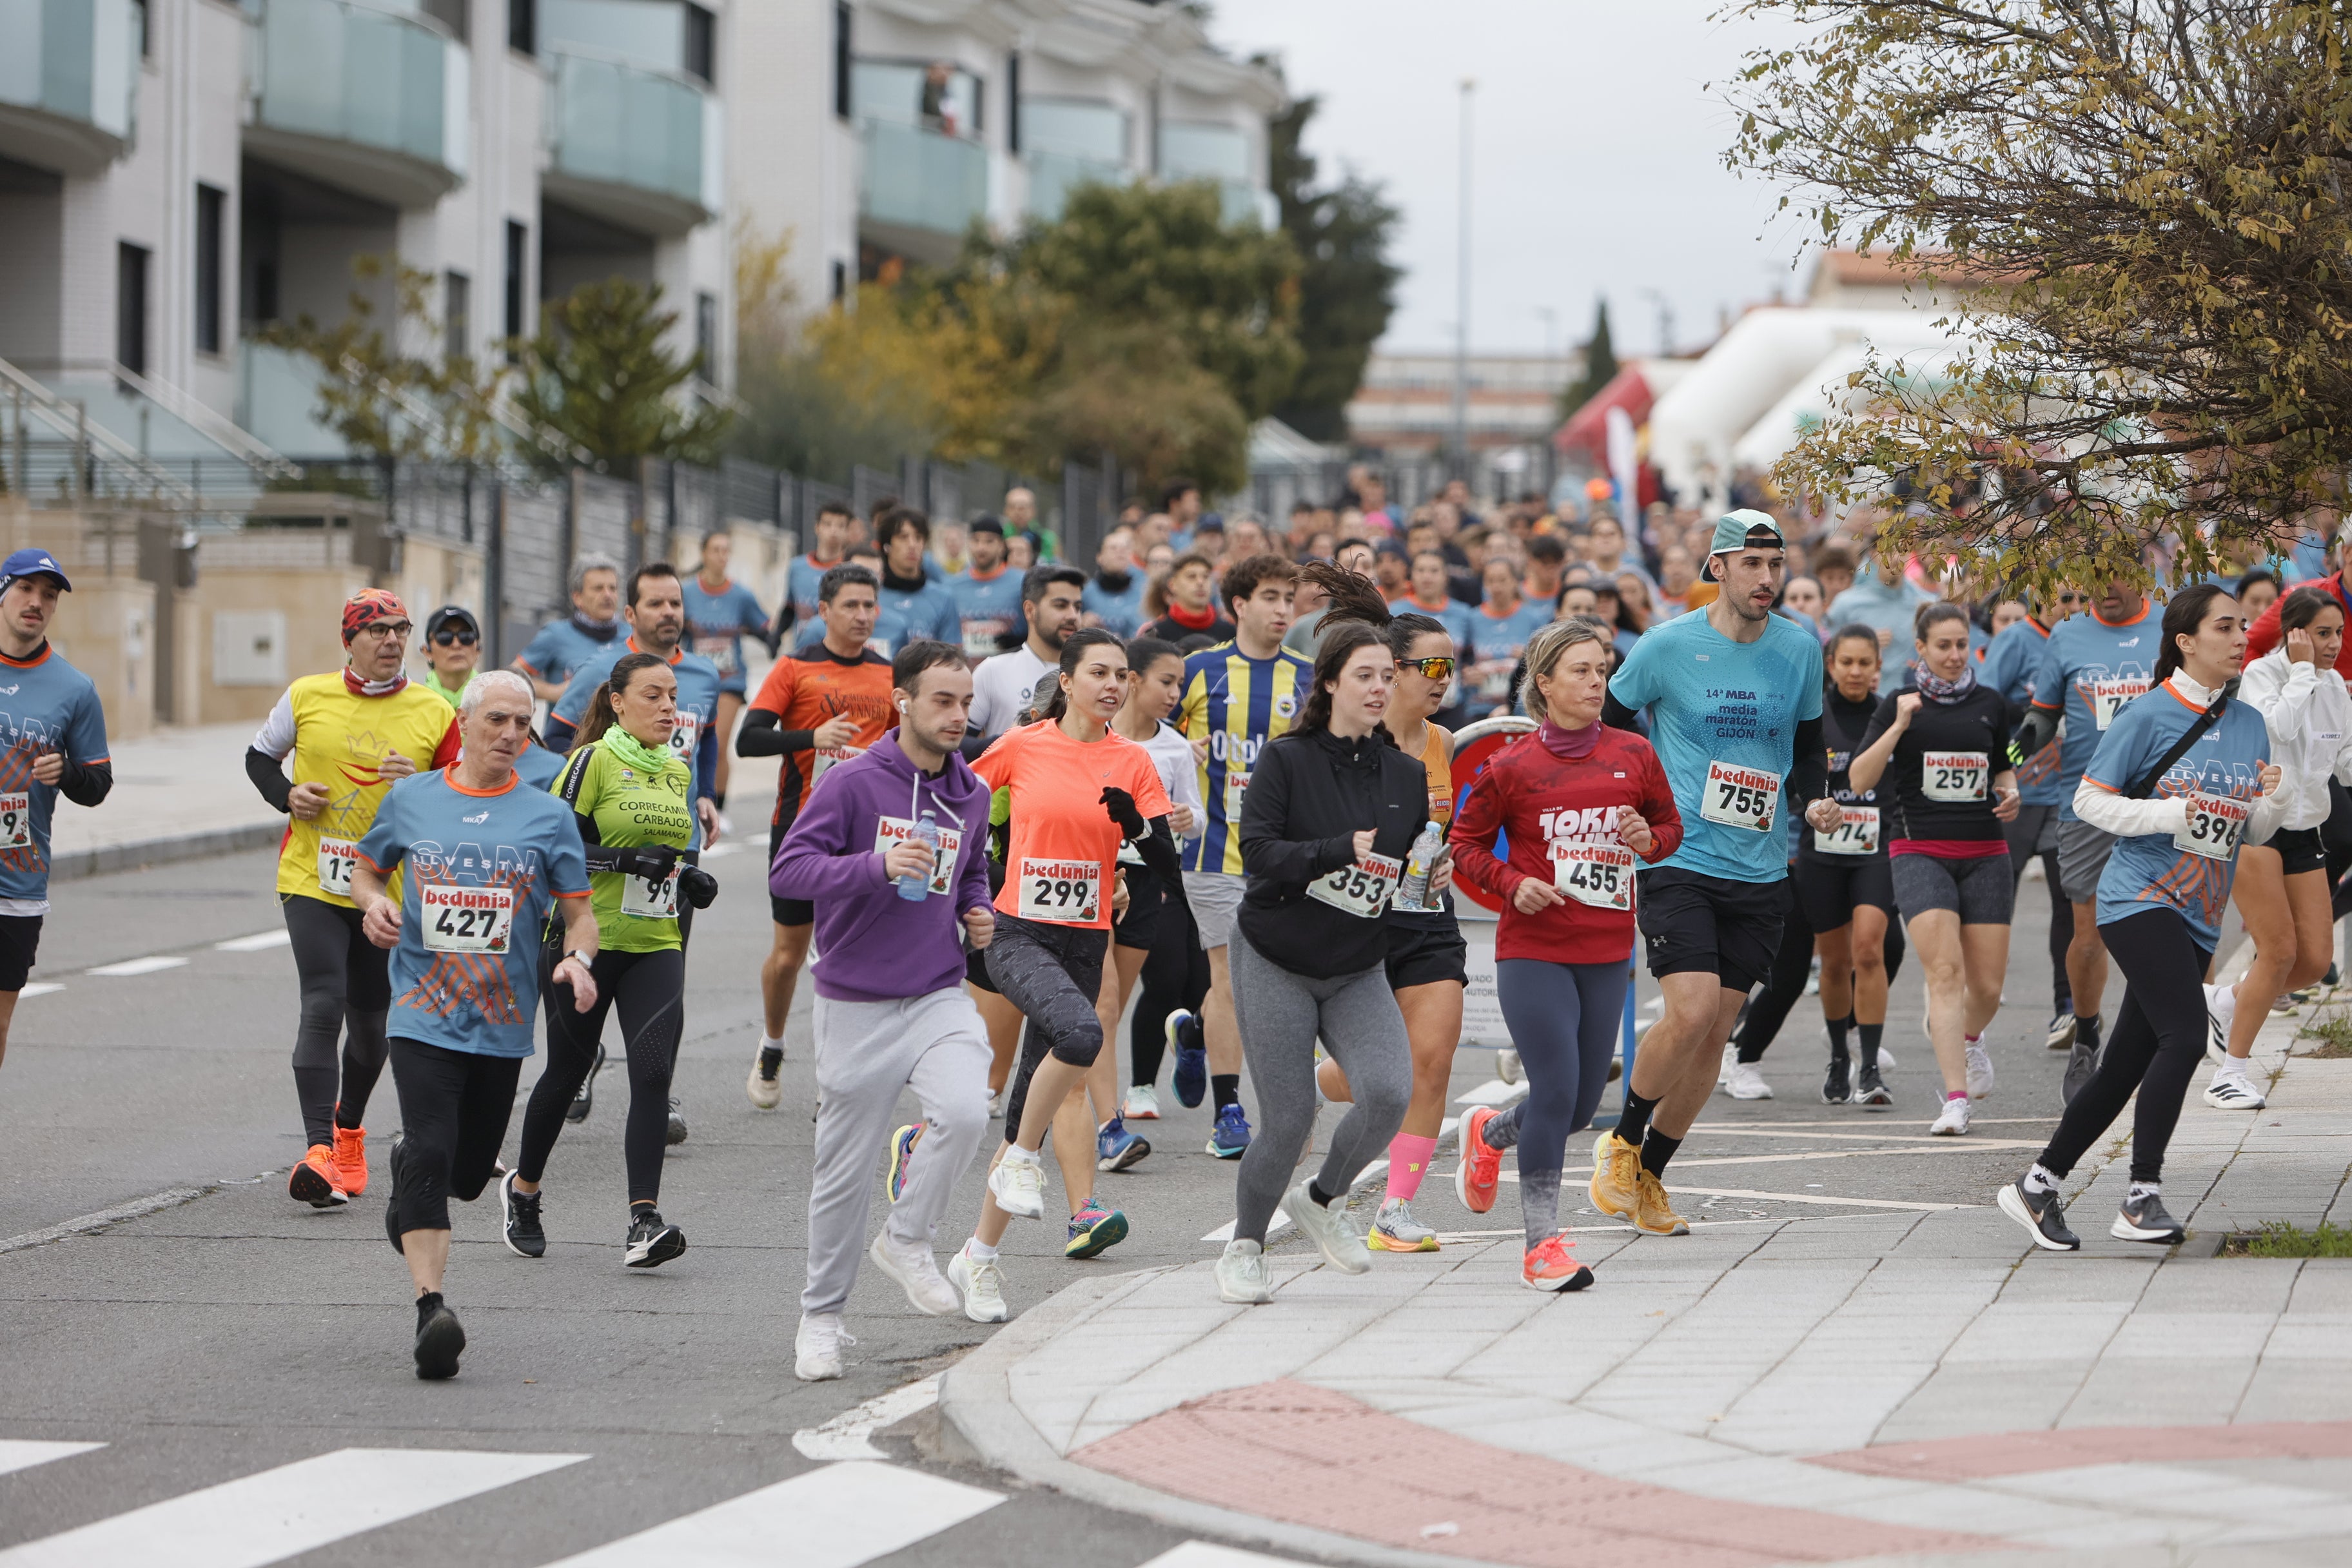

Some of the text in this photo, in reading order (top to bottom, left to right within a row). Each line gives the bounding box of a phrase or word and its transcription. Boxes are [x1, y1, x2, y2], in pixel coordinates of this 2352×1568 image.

[1725, 690, 1756, 700] MBA
[1705, 715, 1757, 726] maratón
[1719, 705, 1758, 716] media
[1716, 727, 1755, 739] GIJÓN
[565, 747, 590, 799] CORRECAMINOS
[1926, 756, 1987, 769] bedunia
[1710, 765, 1778, 792] bedunia
[1936, 768, 1979, 789] 257
[1719, 783, 1768, 817] 755
[2190, 794, 2248, 821] edunia
[643, 828, 687, 841] SALAMANCA
[2191, 813, 2238, 847] 396
[409, 840, 536, 887] SAN
[412, 854, 535, 876] SILVESTRE
[1556, 845, 1632, 867] bedunia
[1023, 861, 1099, 880] bedunia
[1569, 862, 1619, 893] 455
[1034, 879, 1088, 908] 299
[1329, 866, 1386, 904] 353
[425, 889, 511, 909] bedunia
[435, 908, 497, 938] 427
